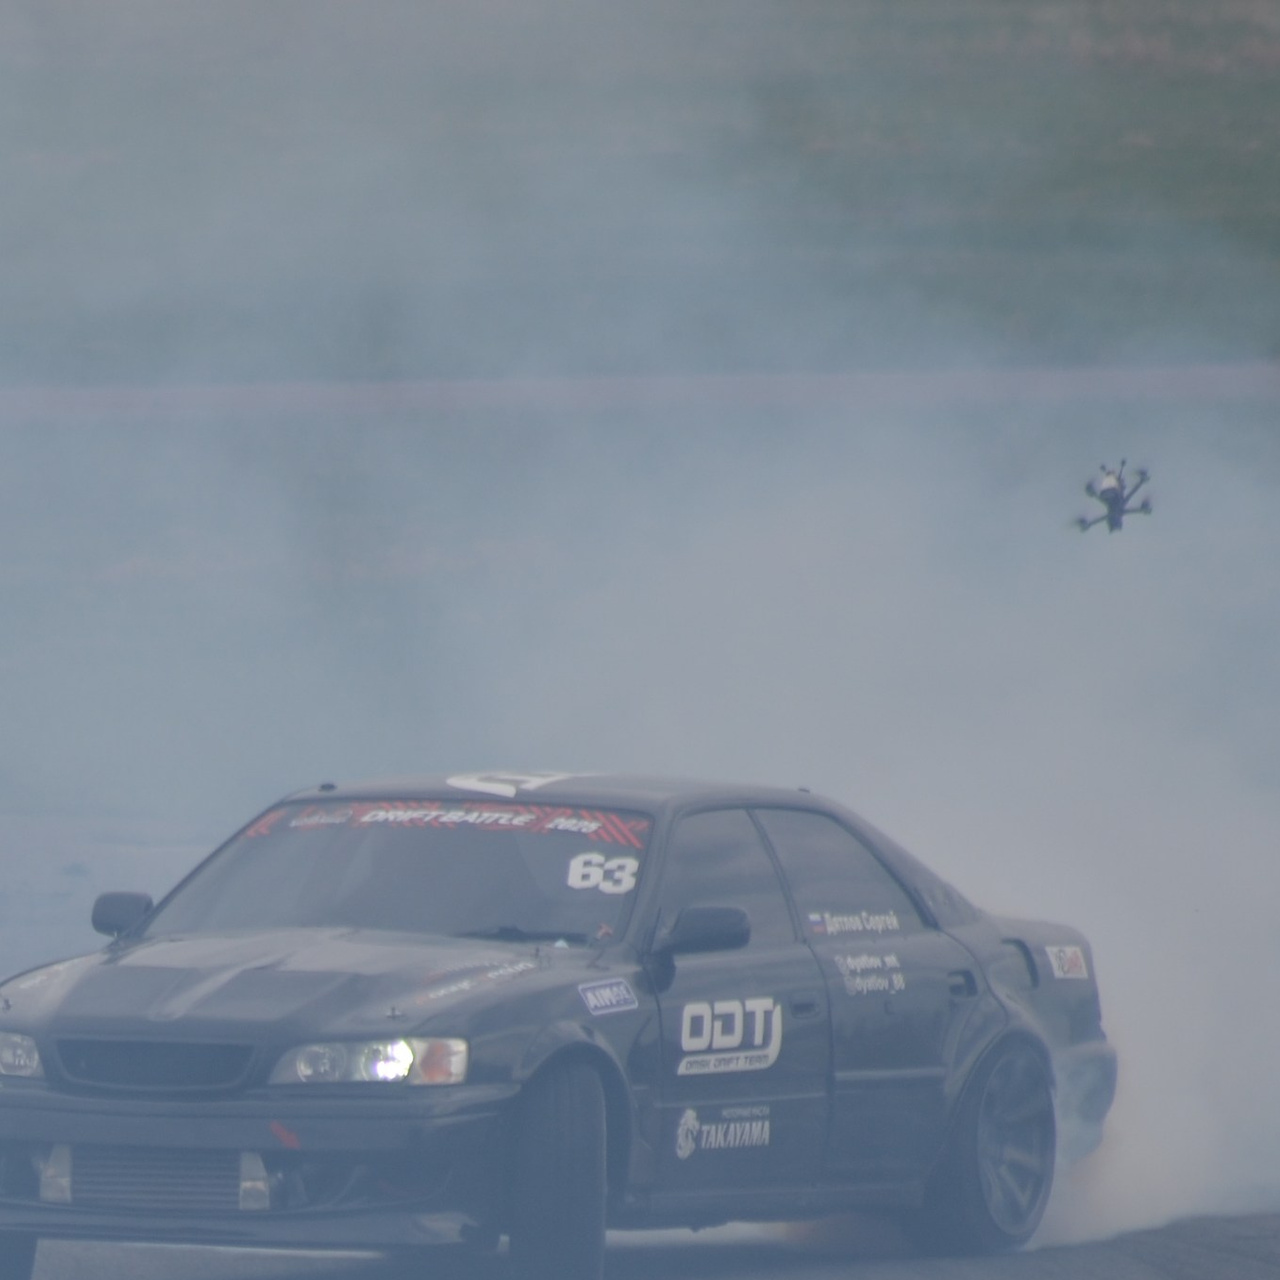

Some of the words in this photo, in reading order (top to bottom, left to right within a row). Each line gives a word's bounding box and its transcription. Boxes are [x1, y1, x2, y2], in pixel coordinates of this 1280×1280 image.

[361, 809, 442, 824] DRIFT
[439, 811, 537, 827] BATTLE
[567, 851, 640, 894] 63
[681, 998, 774, 1052] ODT
[743, 1054, 770, 1066] TEAM
[701, 1120, 770, 1149] TAKAYAMA
